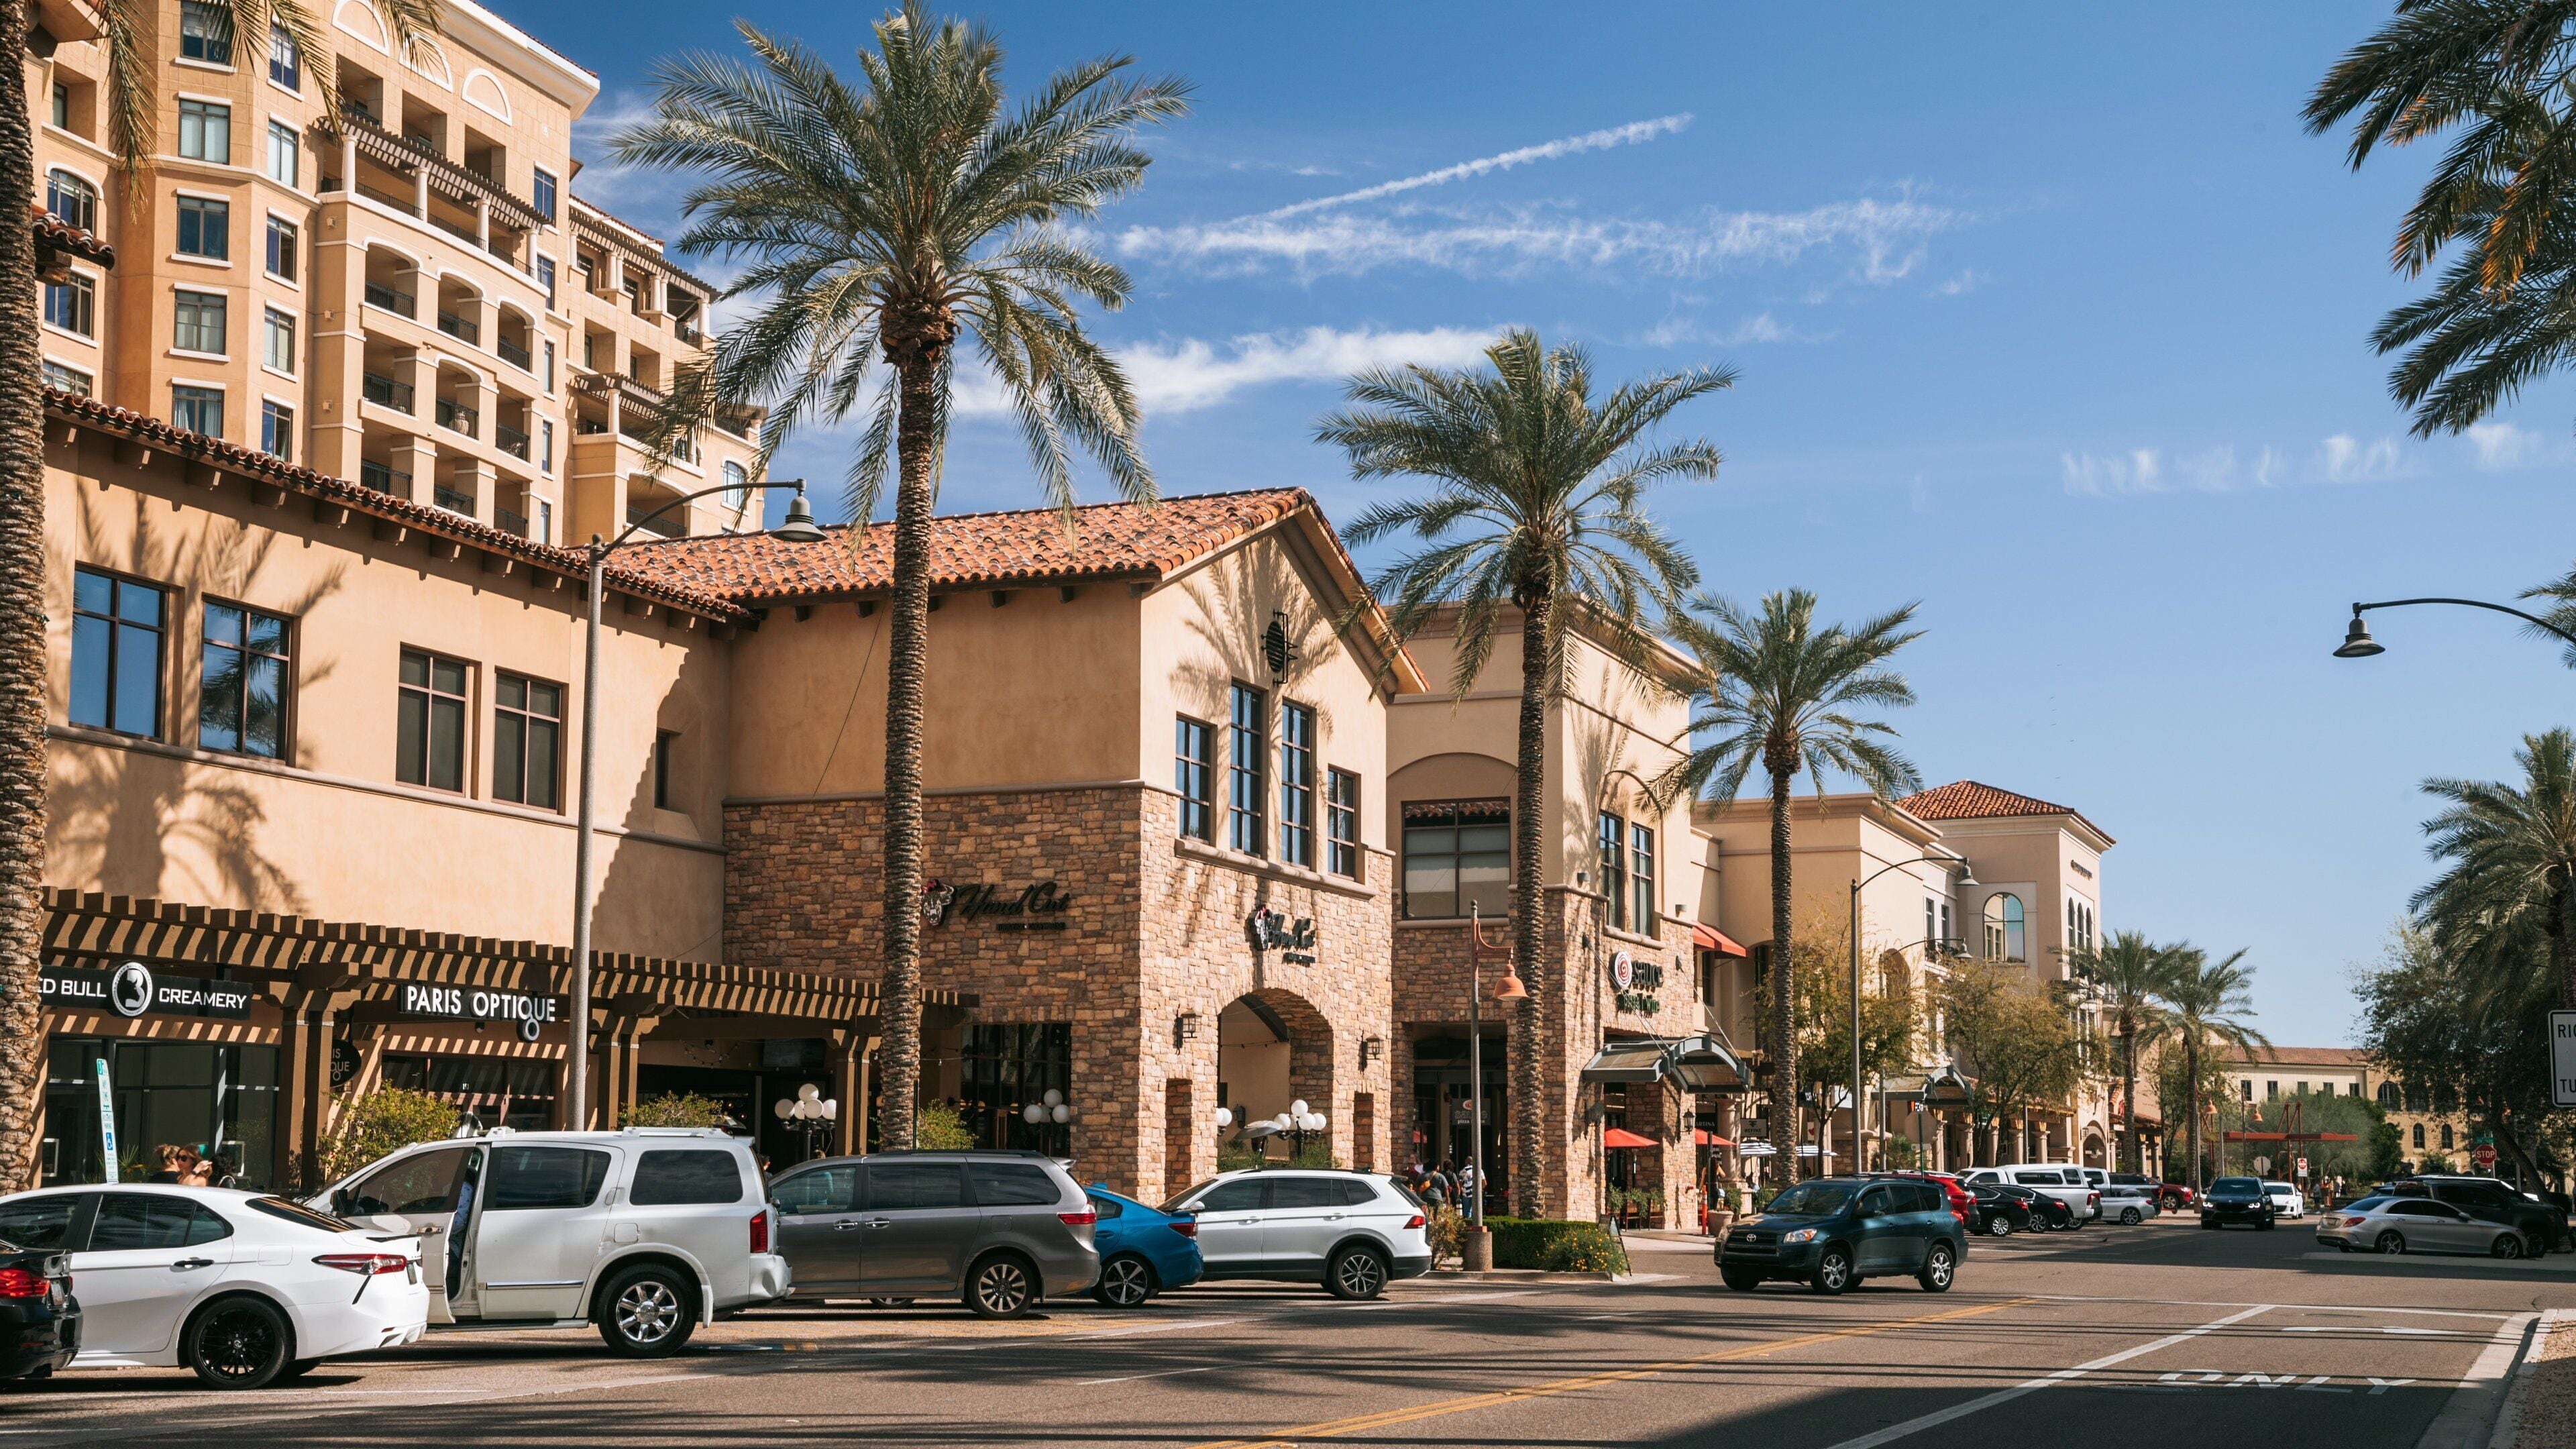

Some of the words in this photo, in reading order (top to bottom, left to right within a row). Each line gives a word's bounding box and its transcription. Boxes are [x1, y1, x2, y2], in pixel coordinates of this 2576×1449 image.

[959, 883, 1034, 921] Hand
[1028, 881, 1069, 913] Cut
[1632, 960, 1663, 987] sauce
[61, 979, 107, 998] BULL
[159, 987, 247, 1009] CREAMERY
[407, 985, 462, 1014] PARIS
[472, 991, 555, 1041] OPTIQUE
[1454, 1111, 1487, 1119] saue
[2476, 1150, 2495, 1159] STOP
[2157, 1368, 2417, 1395] ONLY
